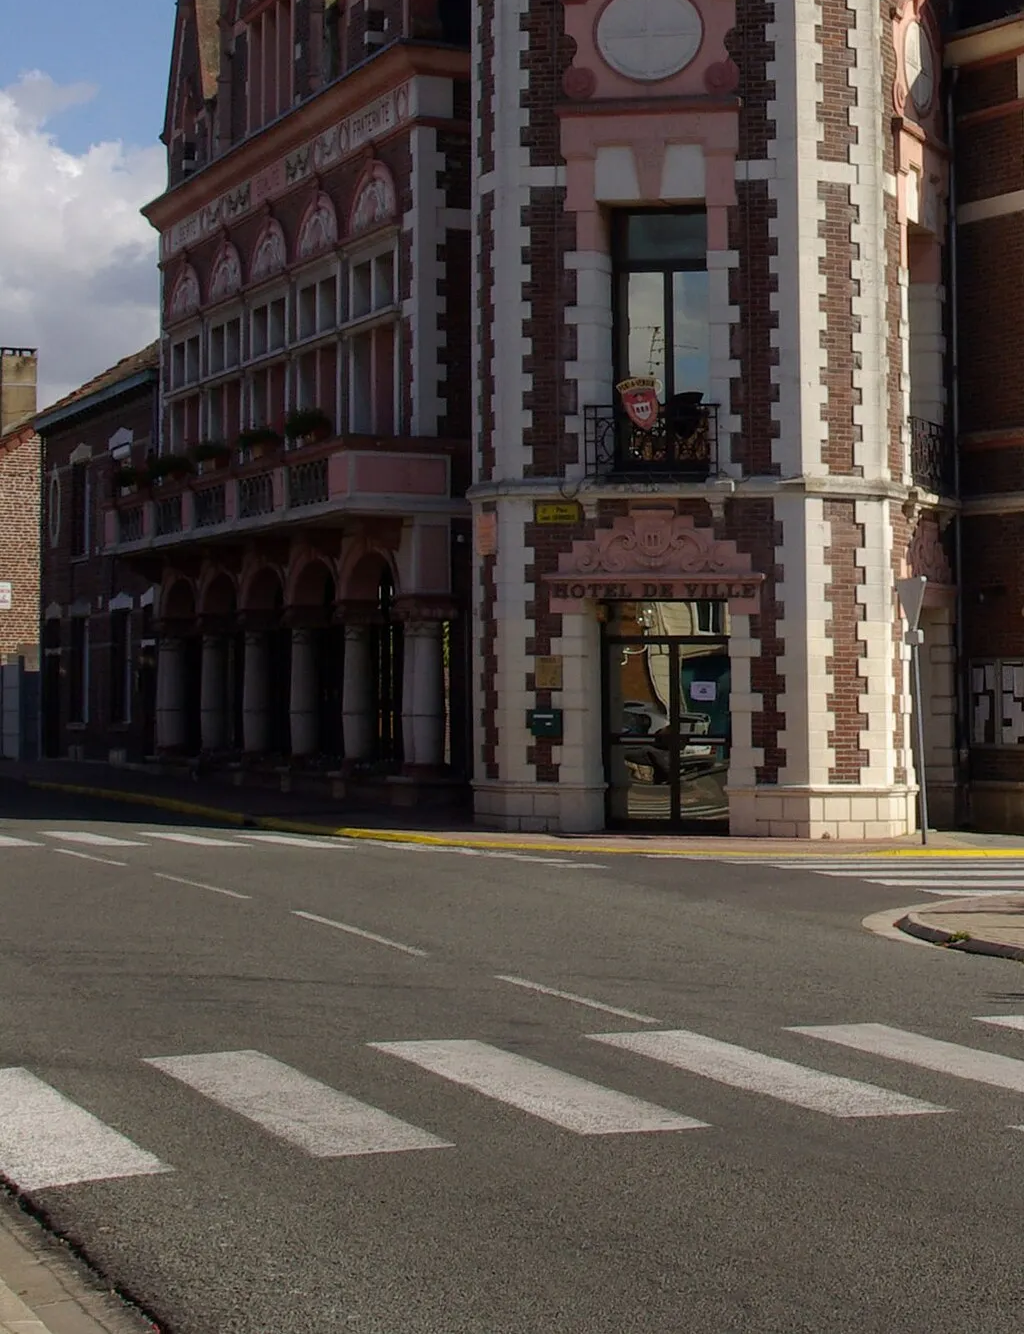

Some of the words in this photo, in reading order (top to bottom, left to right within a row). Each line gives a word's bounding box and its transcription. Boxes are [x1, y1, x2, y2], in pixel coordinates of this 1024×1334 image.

[551, 583, 632, 599] HOTEL
[642, 583, 673, 598] DE
[683, 583, 755, 599] VILLE
